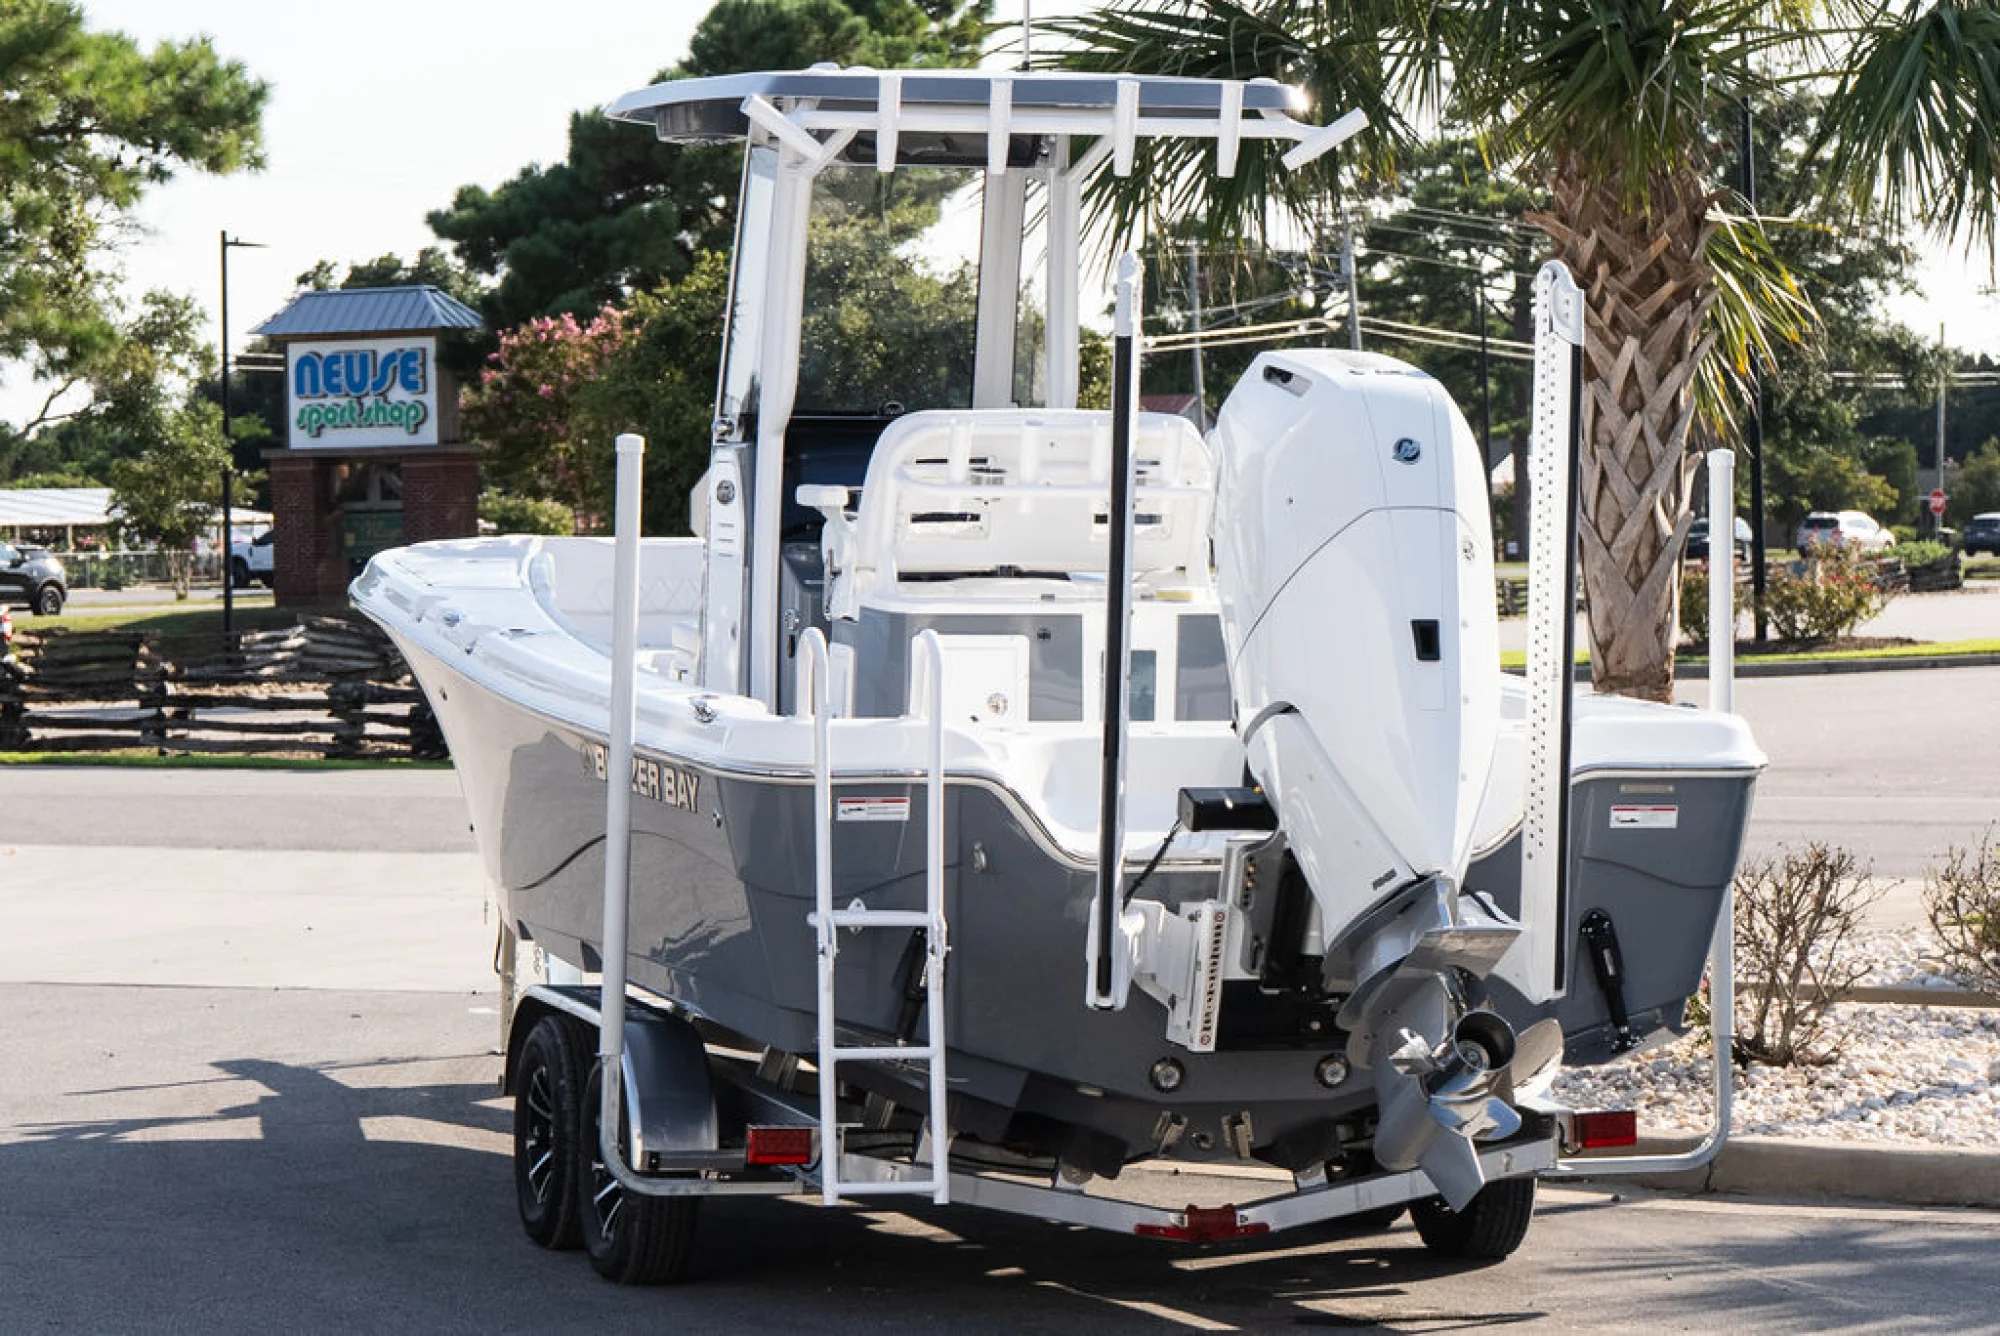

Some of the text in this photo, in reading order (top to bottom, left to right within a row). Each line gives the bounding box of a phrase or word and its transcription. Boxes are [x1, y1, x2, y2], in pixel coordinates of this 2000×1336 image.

[295, 350, 423, 396] NEUSE
[296, 398, 423, 436] sport shop
[595, 744, 699, 813] BZER BAY
